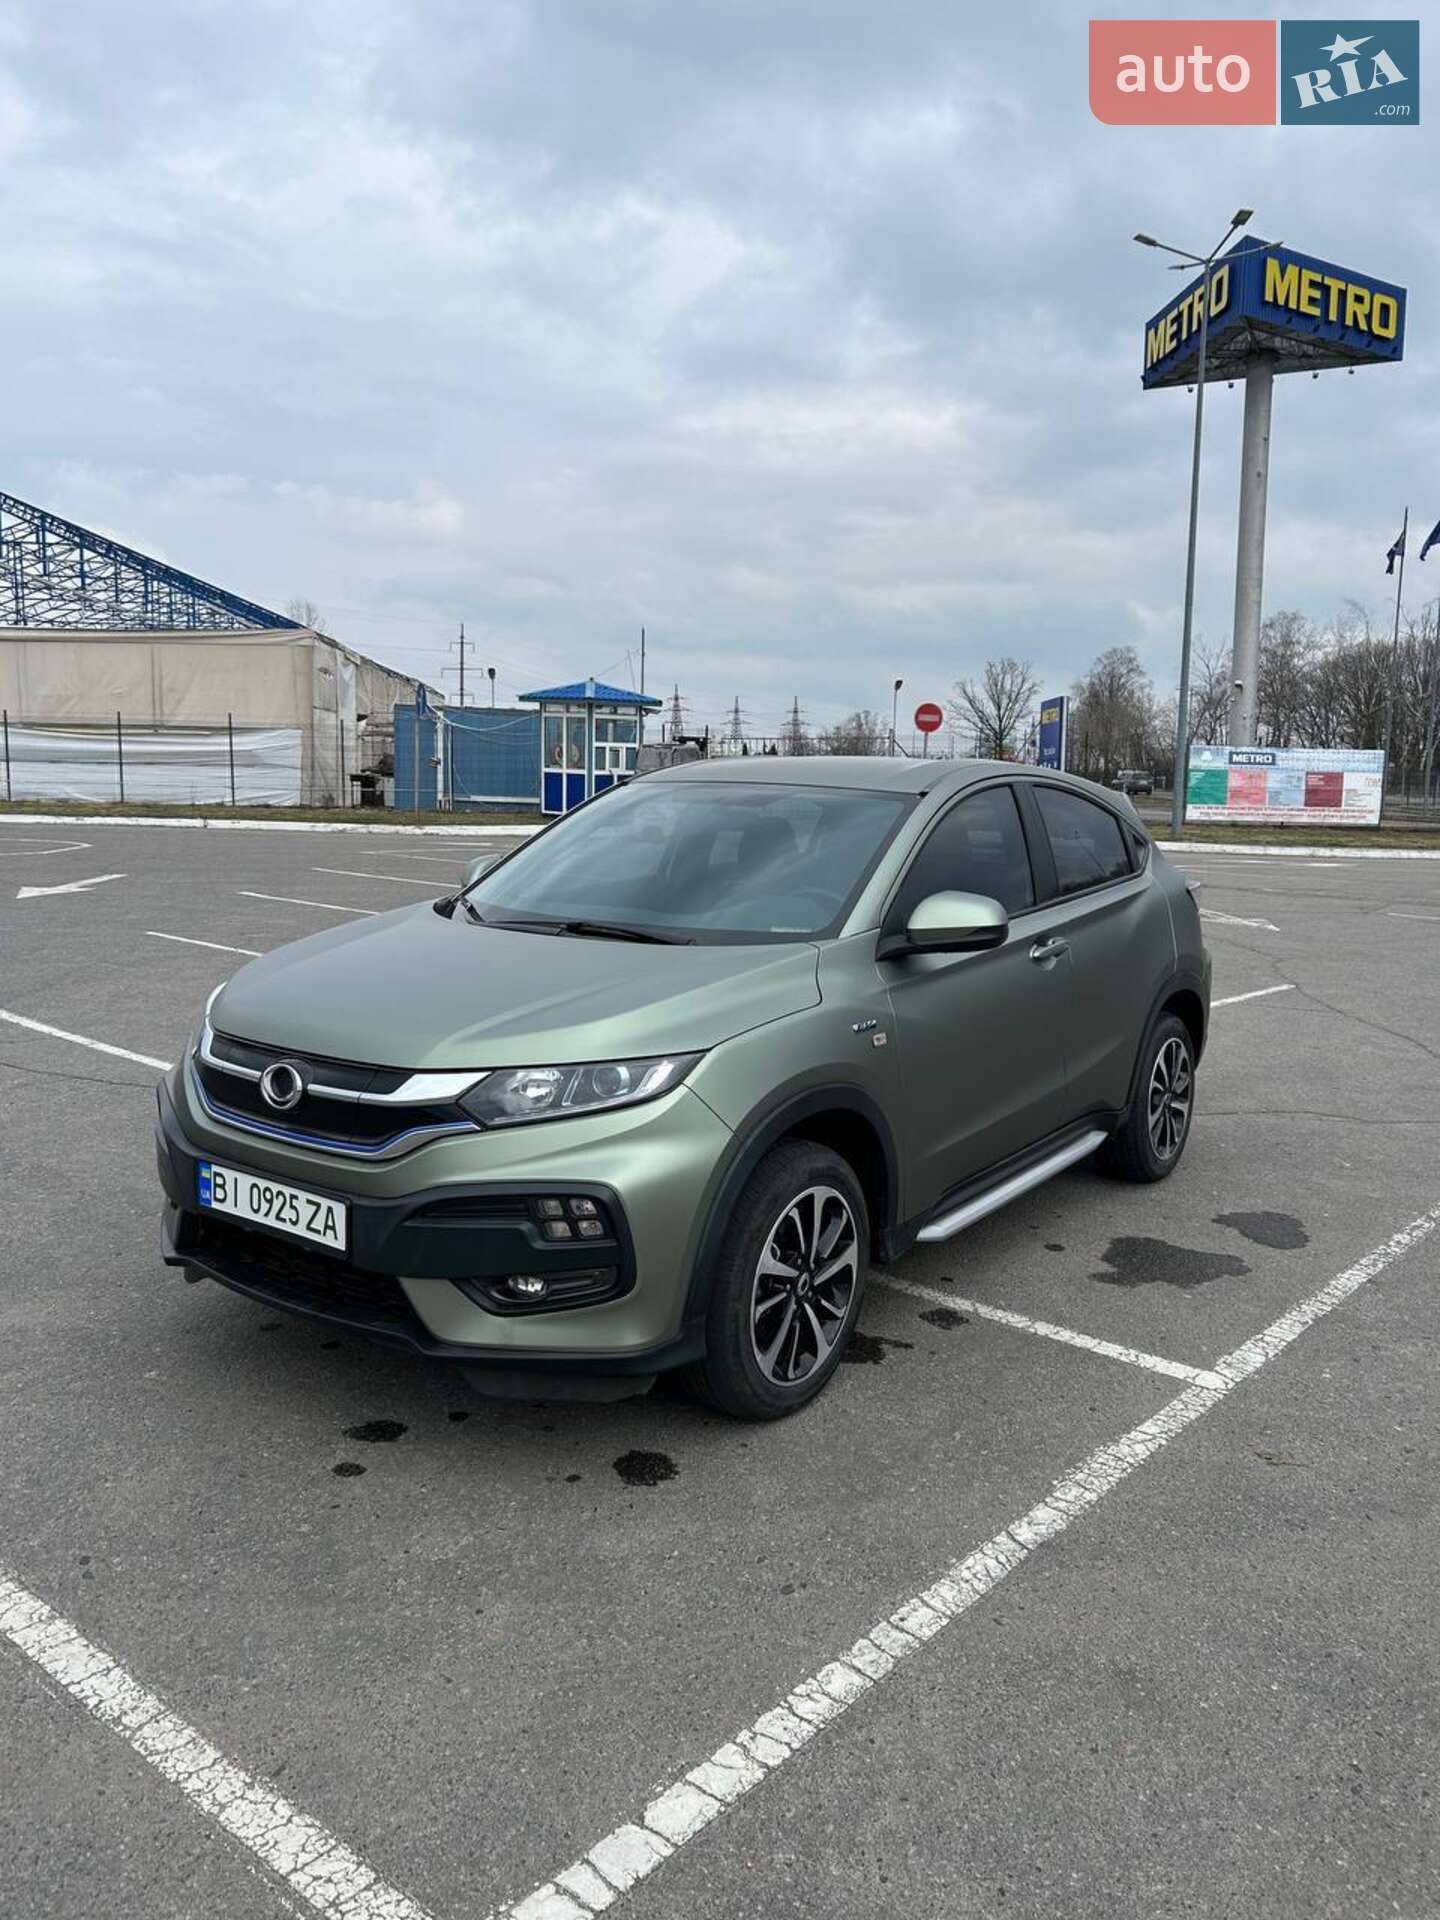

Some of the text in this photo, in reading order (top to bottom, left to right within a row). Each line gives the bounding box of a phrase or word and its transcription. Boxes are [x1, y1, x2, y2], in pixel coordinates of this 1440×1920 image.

[1146, 263, 1229, 369] METRO
[1264, 257, 1398, 340] METRO
[1232, 754, 1273, 763] METRO
[213, 1171, 338, 1240] BI 0925 ZA
